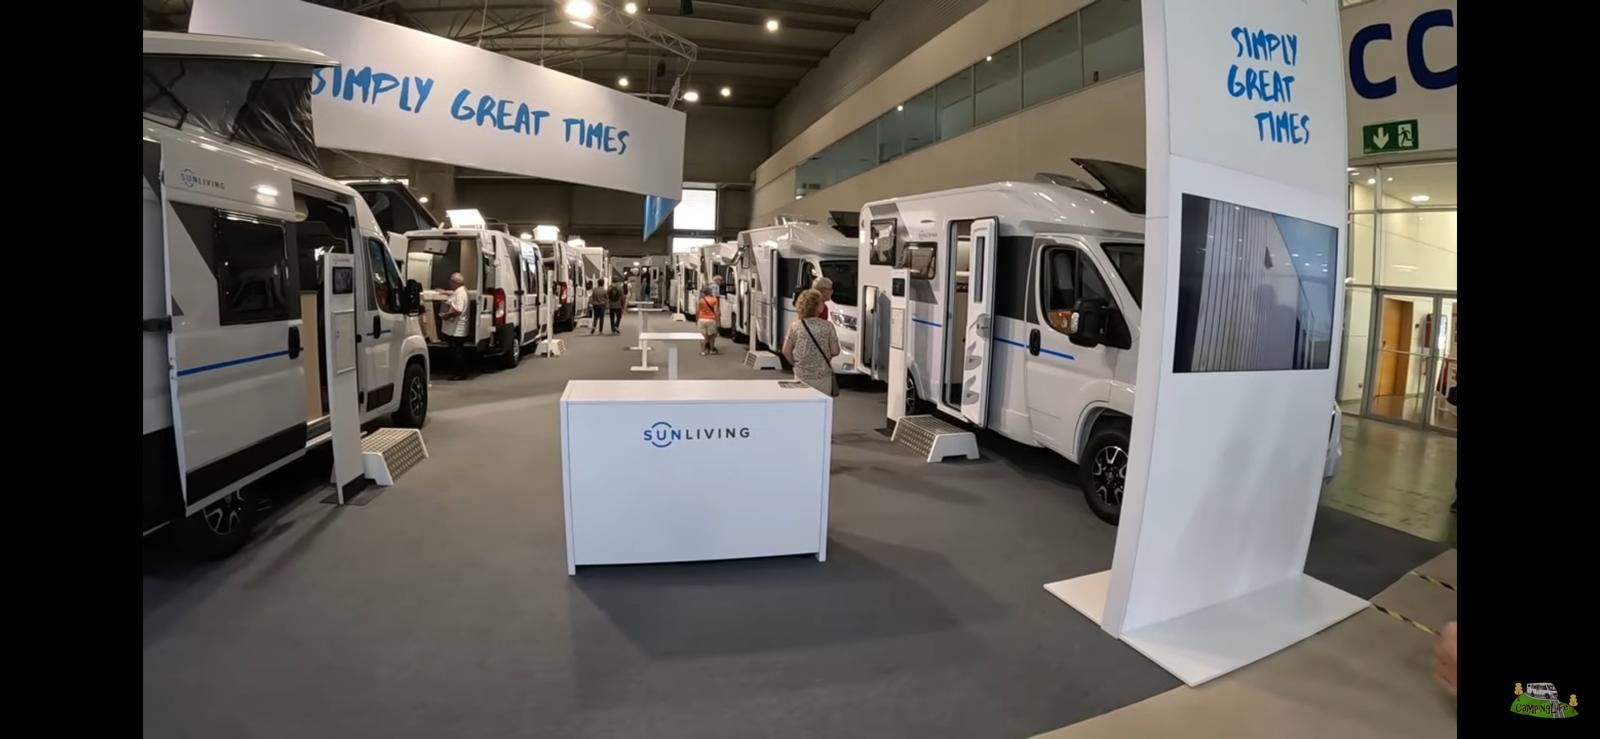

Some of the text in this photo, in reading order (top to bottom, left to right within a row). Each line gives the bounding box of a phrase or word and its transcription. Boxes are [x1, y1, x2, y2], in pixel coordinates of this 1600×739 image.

[1231, 26, 1297, 66] SIMPLY
[1227, 65, 1295, 103] GREAT
[450, 89, 551, 135] GREAT
[563, 117, 630, 155] TIMES
[1254, 111, 1310, 145] TIMES
[180, 169, 226, 190] SUNLIVING
[643, 423, 751, 446] SUNLIVING
